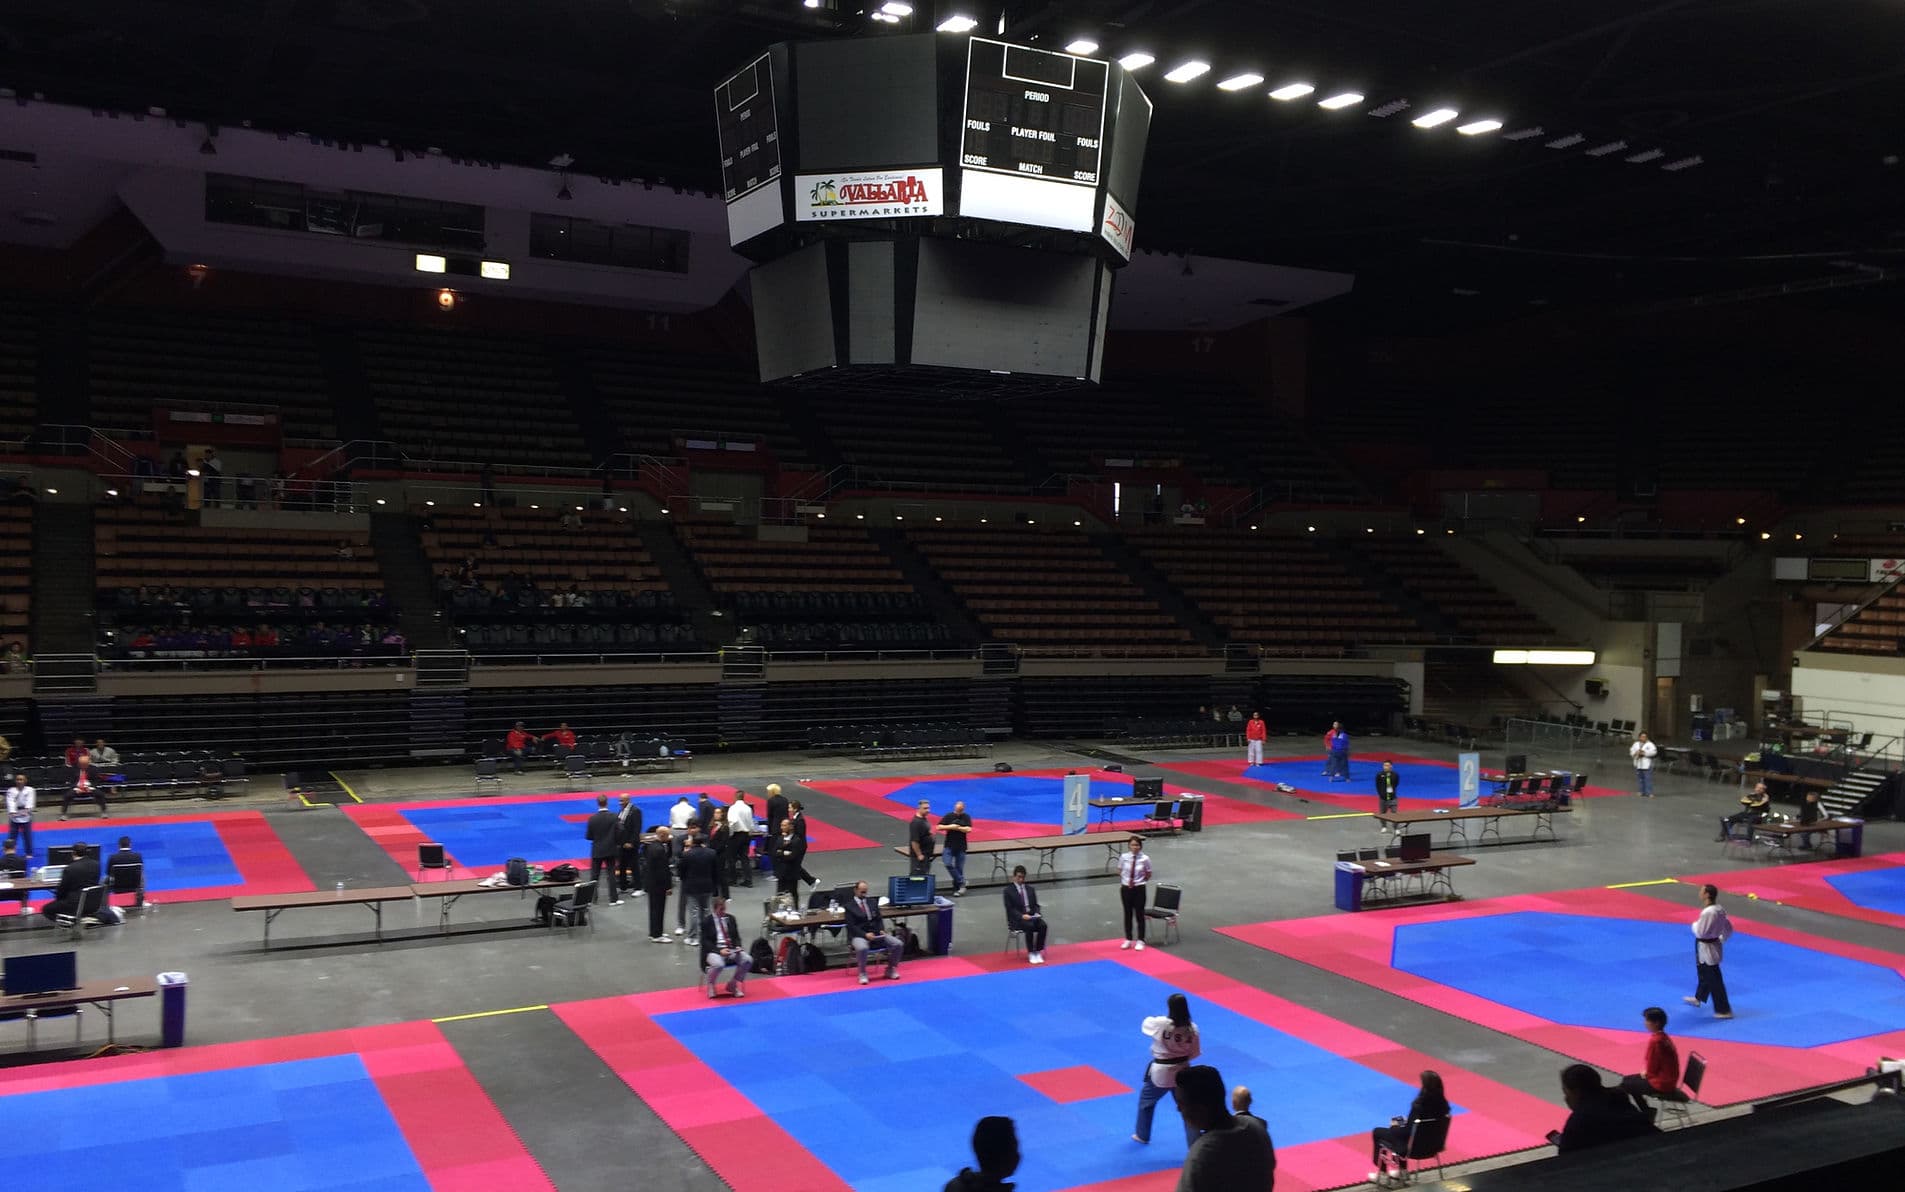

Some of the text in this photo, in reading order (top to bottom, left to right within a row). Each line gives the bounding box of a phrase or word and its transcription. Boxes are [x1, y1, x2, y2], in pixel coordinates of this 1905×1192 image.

[1024, 90, 1049, 103] PERIOD
[967, 119, 991, 132] FOULS
[1011, 126, 1057, 142] PLAYER FOUL
[1077, 137, 1099, 149] FOULS
[964, 154, 988, 166] SCORE
[1018, 162, 1043, 174] MATCH
[1073, 170, 1096, 182] SCORE
[840, 176, 929, 205] VALLARTA
[811, 206, 928, 218] SUPERMARKETS
[439, 292, 454, 312] 9
[1463, 760, 1475, 791] 2
[1069, 783, 1084, 818] 4
